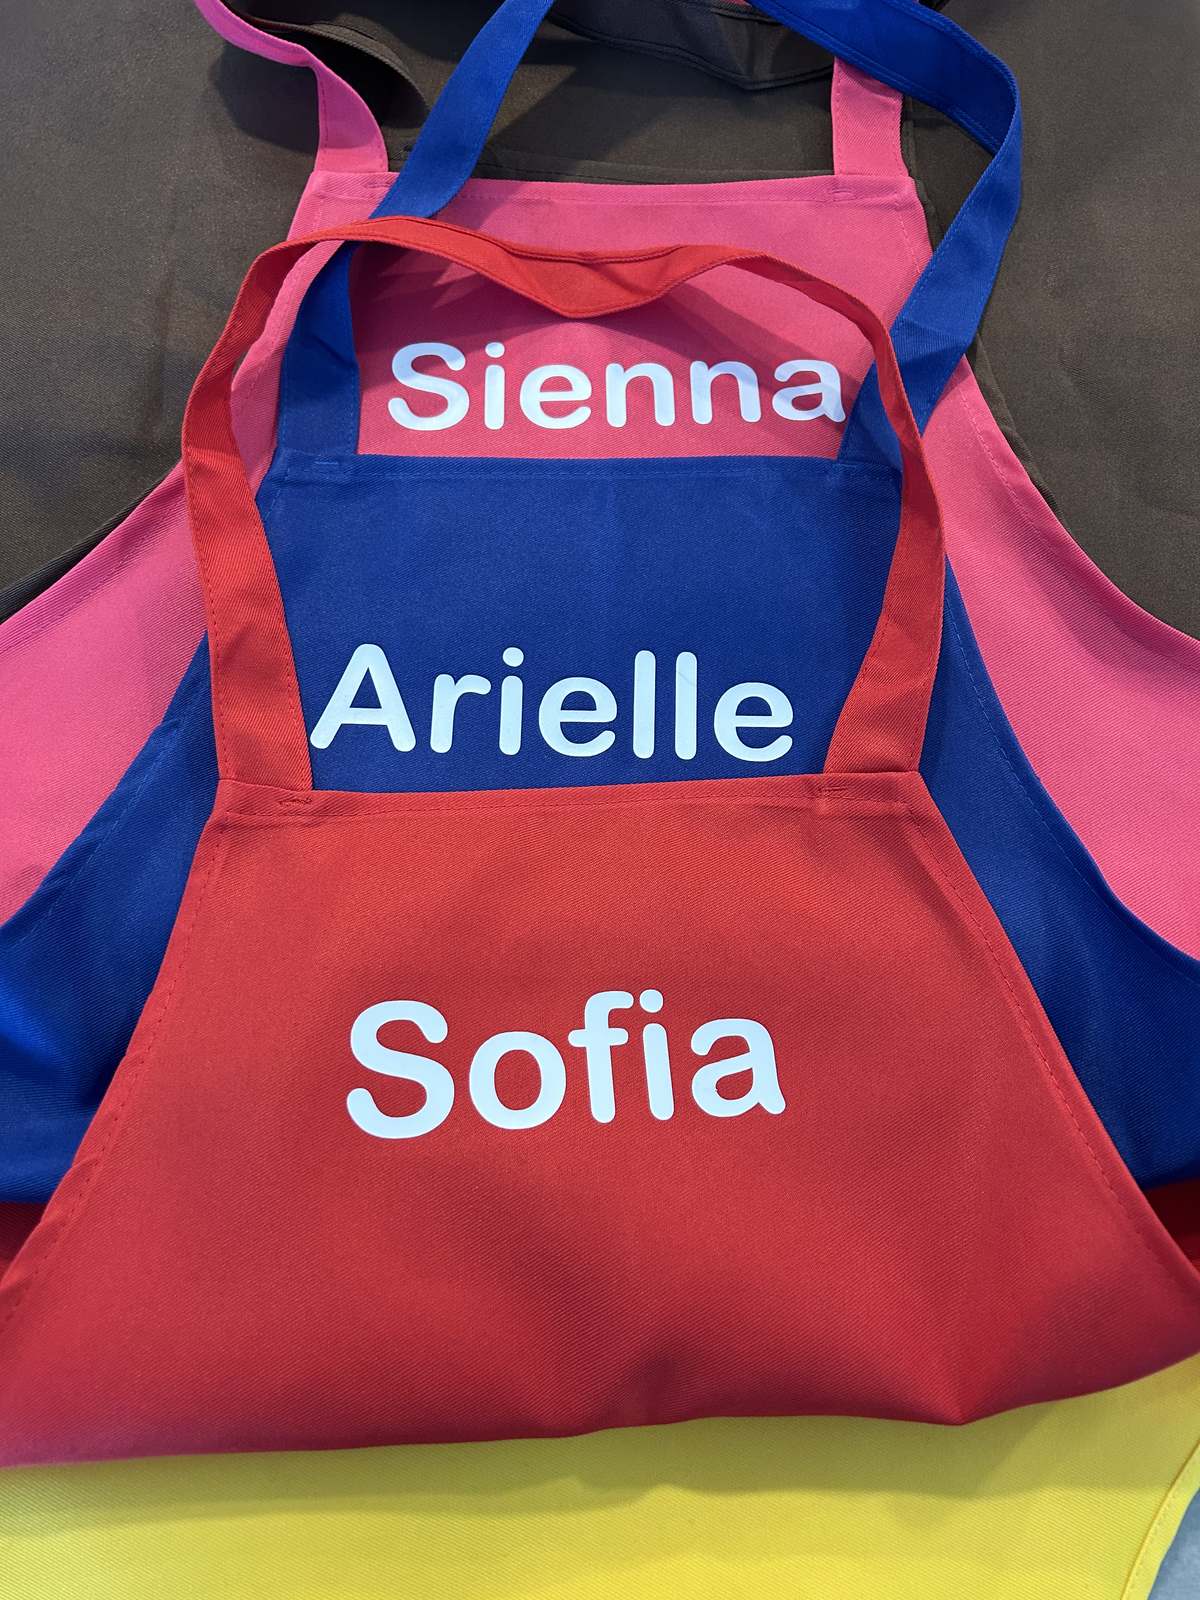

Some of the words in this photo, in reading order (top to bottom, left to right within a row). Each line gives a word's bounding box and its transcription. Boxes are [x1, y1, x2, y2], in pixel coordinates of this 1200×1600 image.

[387, 341, 846, 432] Sienna
[309, 643, 794, 762] Arielle
[346, 988, 786, 1140] Sofia
